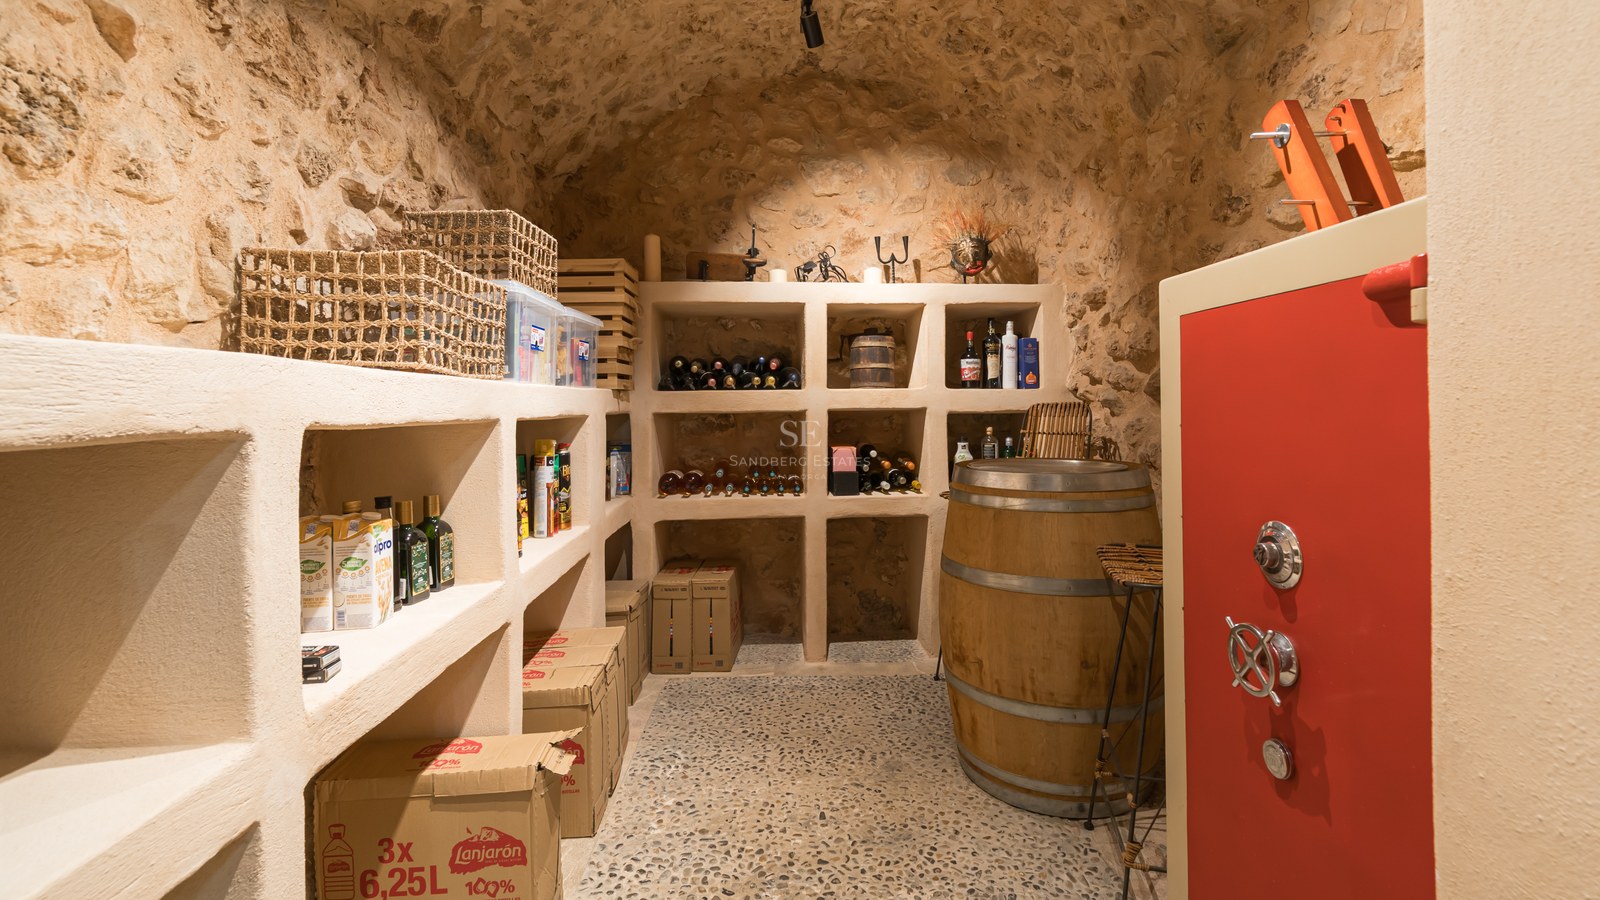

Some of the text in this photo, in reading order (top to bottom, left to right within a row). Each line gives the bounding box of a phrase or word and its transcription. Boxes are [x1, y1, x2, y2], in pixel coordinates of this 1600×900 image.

[373, 539, 392, 556] alpro
[377, 837, 414, 864] 3x
[454, 844, 522, 865] Lanjarón
[359, 865, 449, 900] 6,25L
[465, 877, 515, 898] 100%
